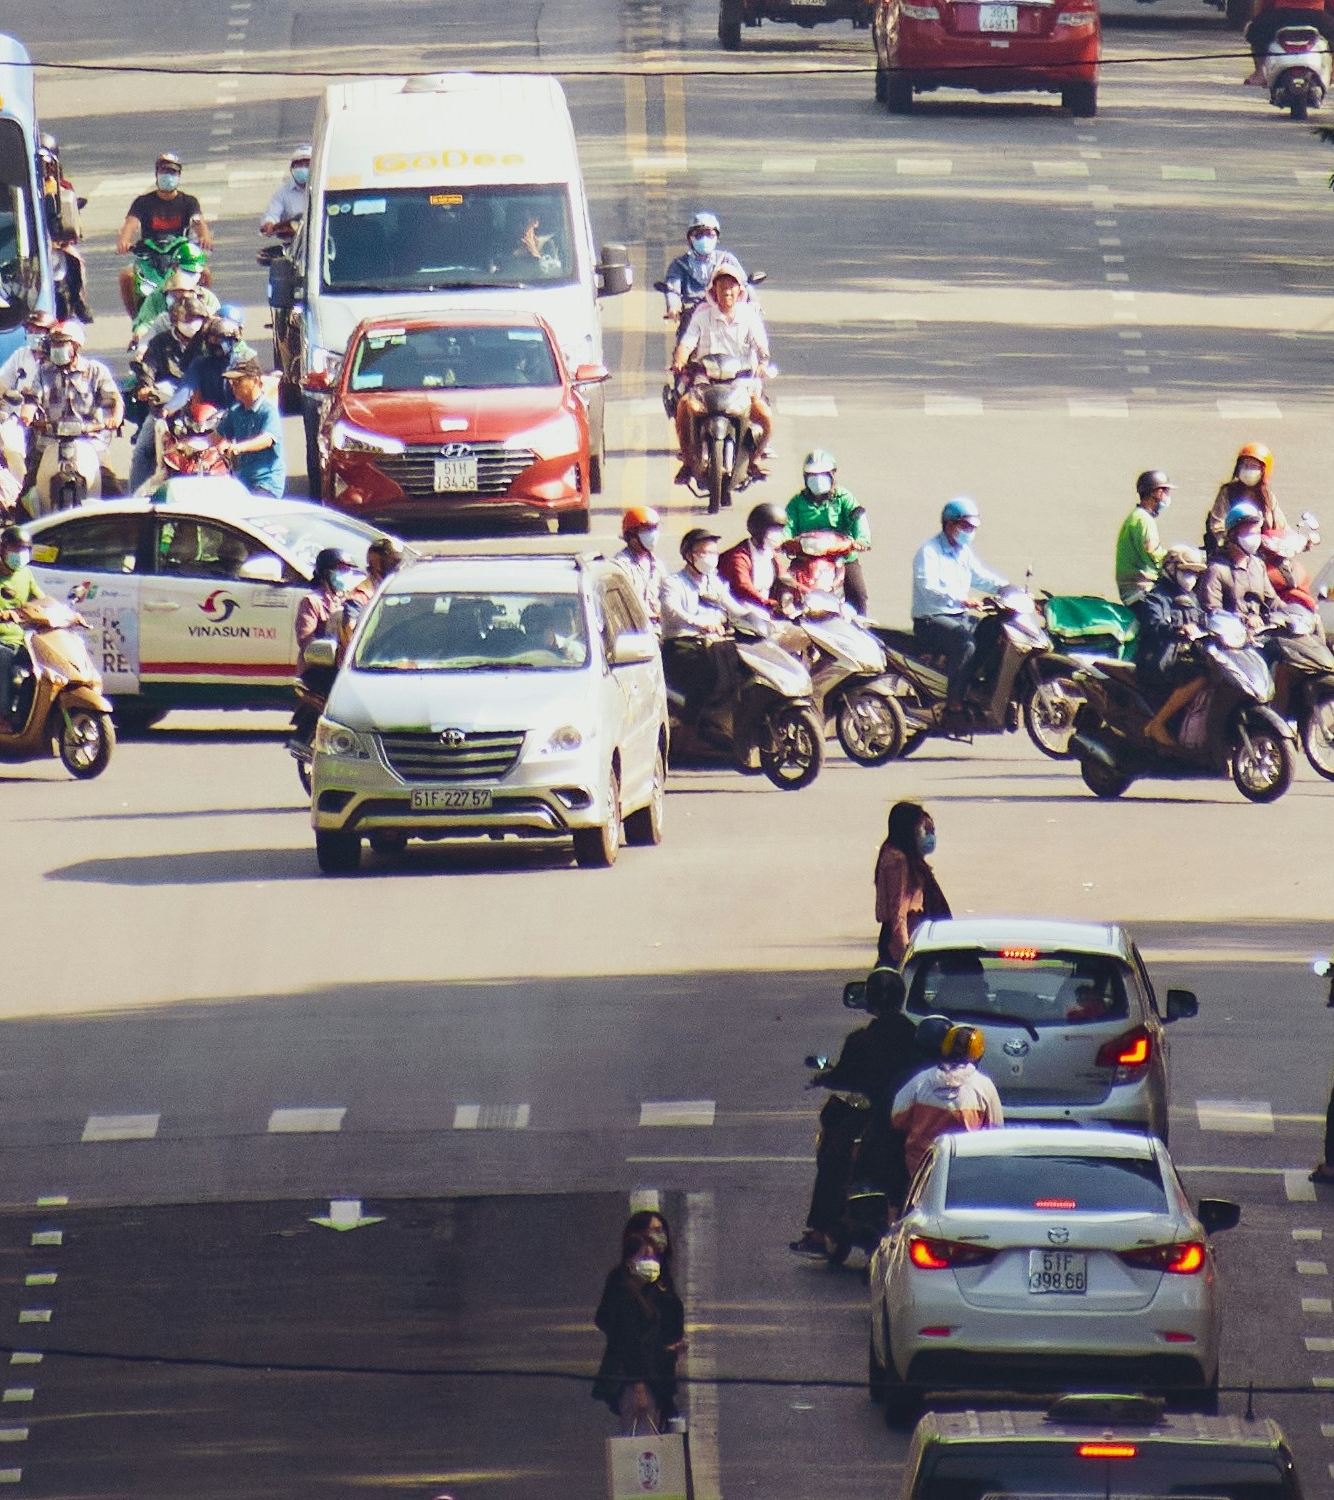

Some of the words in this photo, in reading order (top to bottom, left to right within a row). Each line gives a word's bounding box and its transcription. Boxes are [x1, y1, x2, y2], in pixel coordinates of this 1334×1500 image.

[372, 150, 525, 176] GoDee
[188, 625, 250, 640] VINASUN
[253, 626, 276, 640] TAXI
[414, 791, 492, 808] 51F-227.57
[1043, 1252, 1073, 1271] 51F
